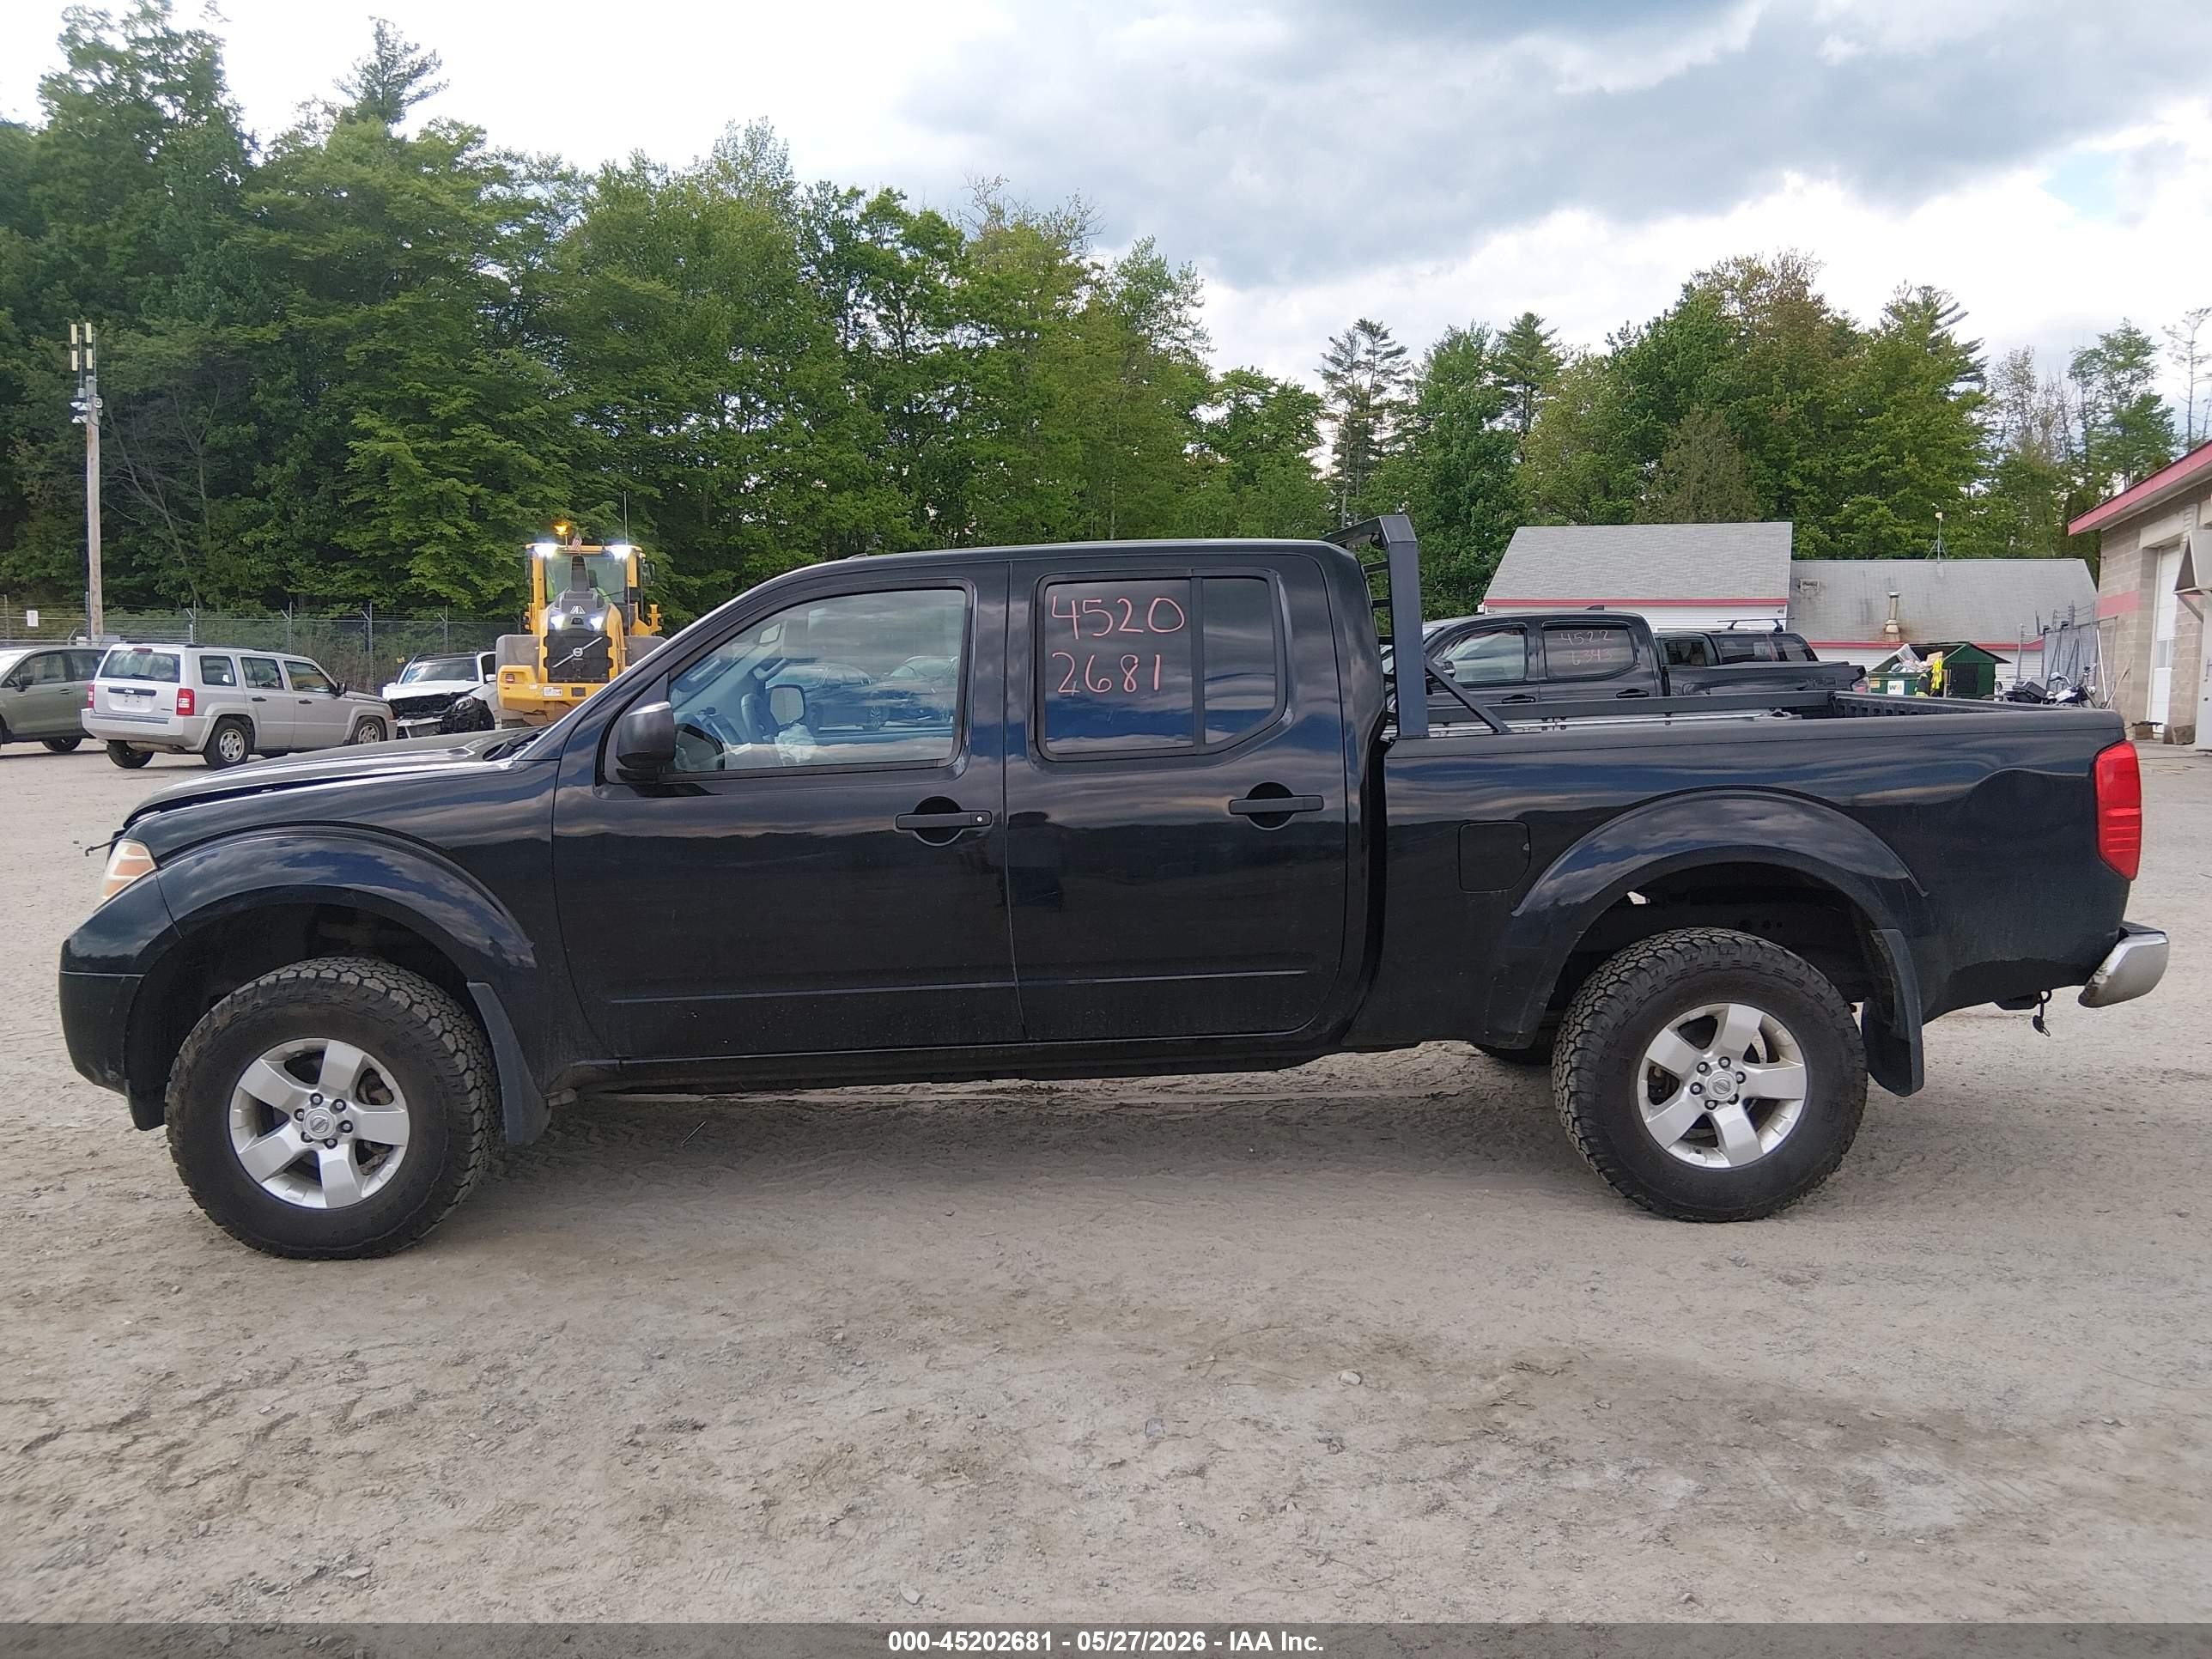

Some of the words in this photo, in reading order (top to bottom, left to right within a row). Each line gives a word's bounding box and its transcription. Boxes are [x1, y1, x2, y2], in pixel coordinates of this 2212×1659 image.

[1052, 596, 1185, 640] 4520
[1560, 629, 1613, 646] 4522
[1052, 652, 1162, 694] 2681
